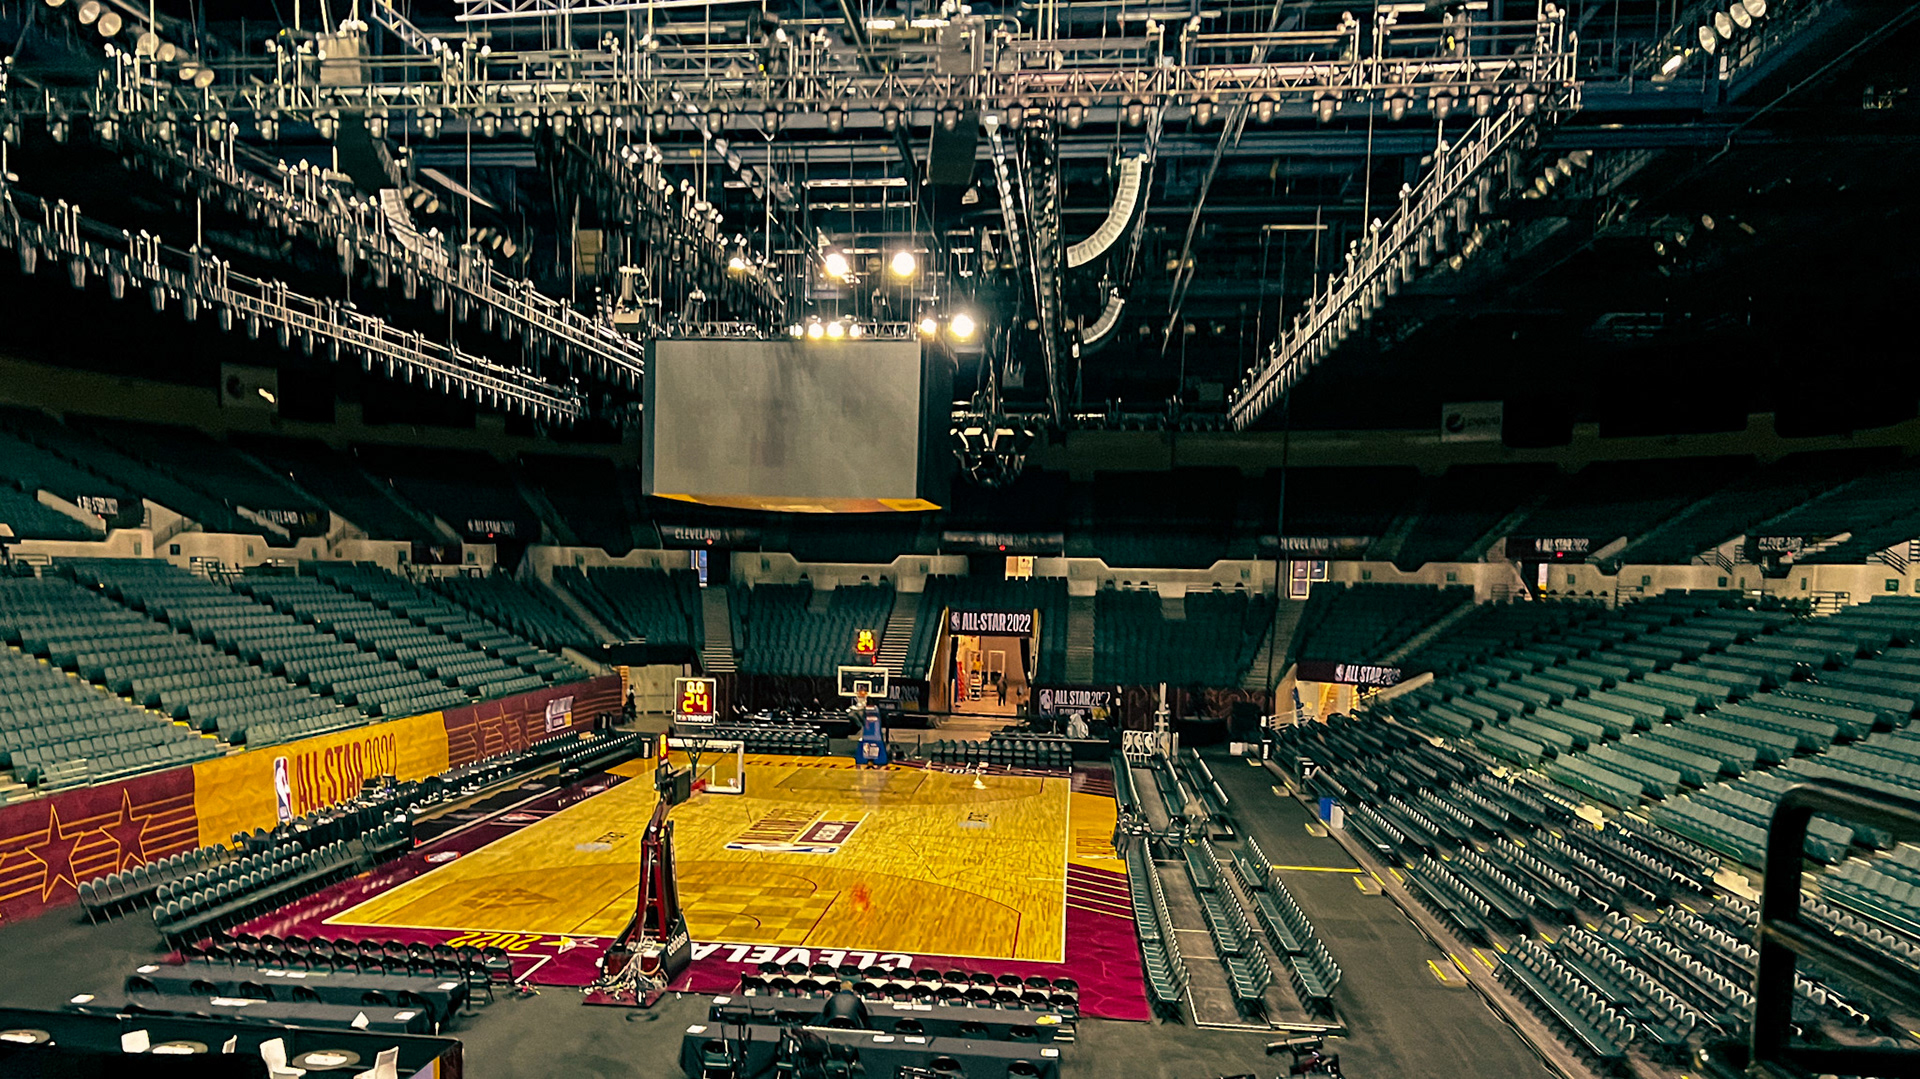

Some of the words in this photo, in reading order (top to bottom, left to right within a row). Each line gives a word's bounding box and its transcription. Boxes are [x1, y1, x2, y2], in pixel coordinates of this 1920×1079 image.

[674, 527, 722, 541] CLEVELAND
[1007, 613, 1031, 633] 2022
[1359, 665, 1383, 684] STAR
[682, 692, 708, 713] 24
[1054, 689, 1069, 705] ALL
[1069, 690, 1091, 706] STAR
[1091, 691, 1111, 707] 202
[446, 931, 543, 951] 2022
[666, 931, 688, 956] coinbase
[690, 943, 914, 972] CLEVELA
